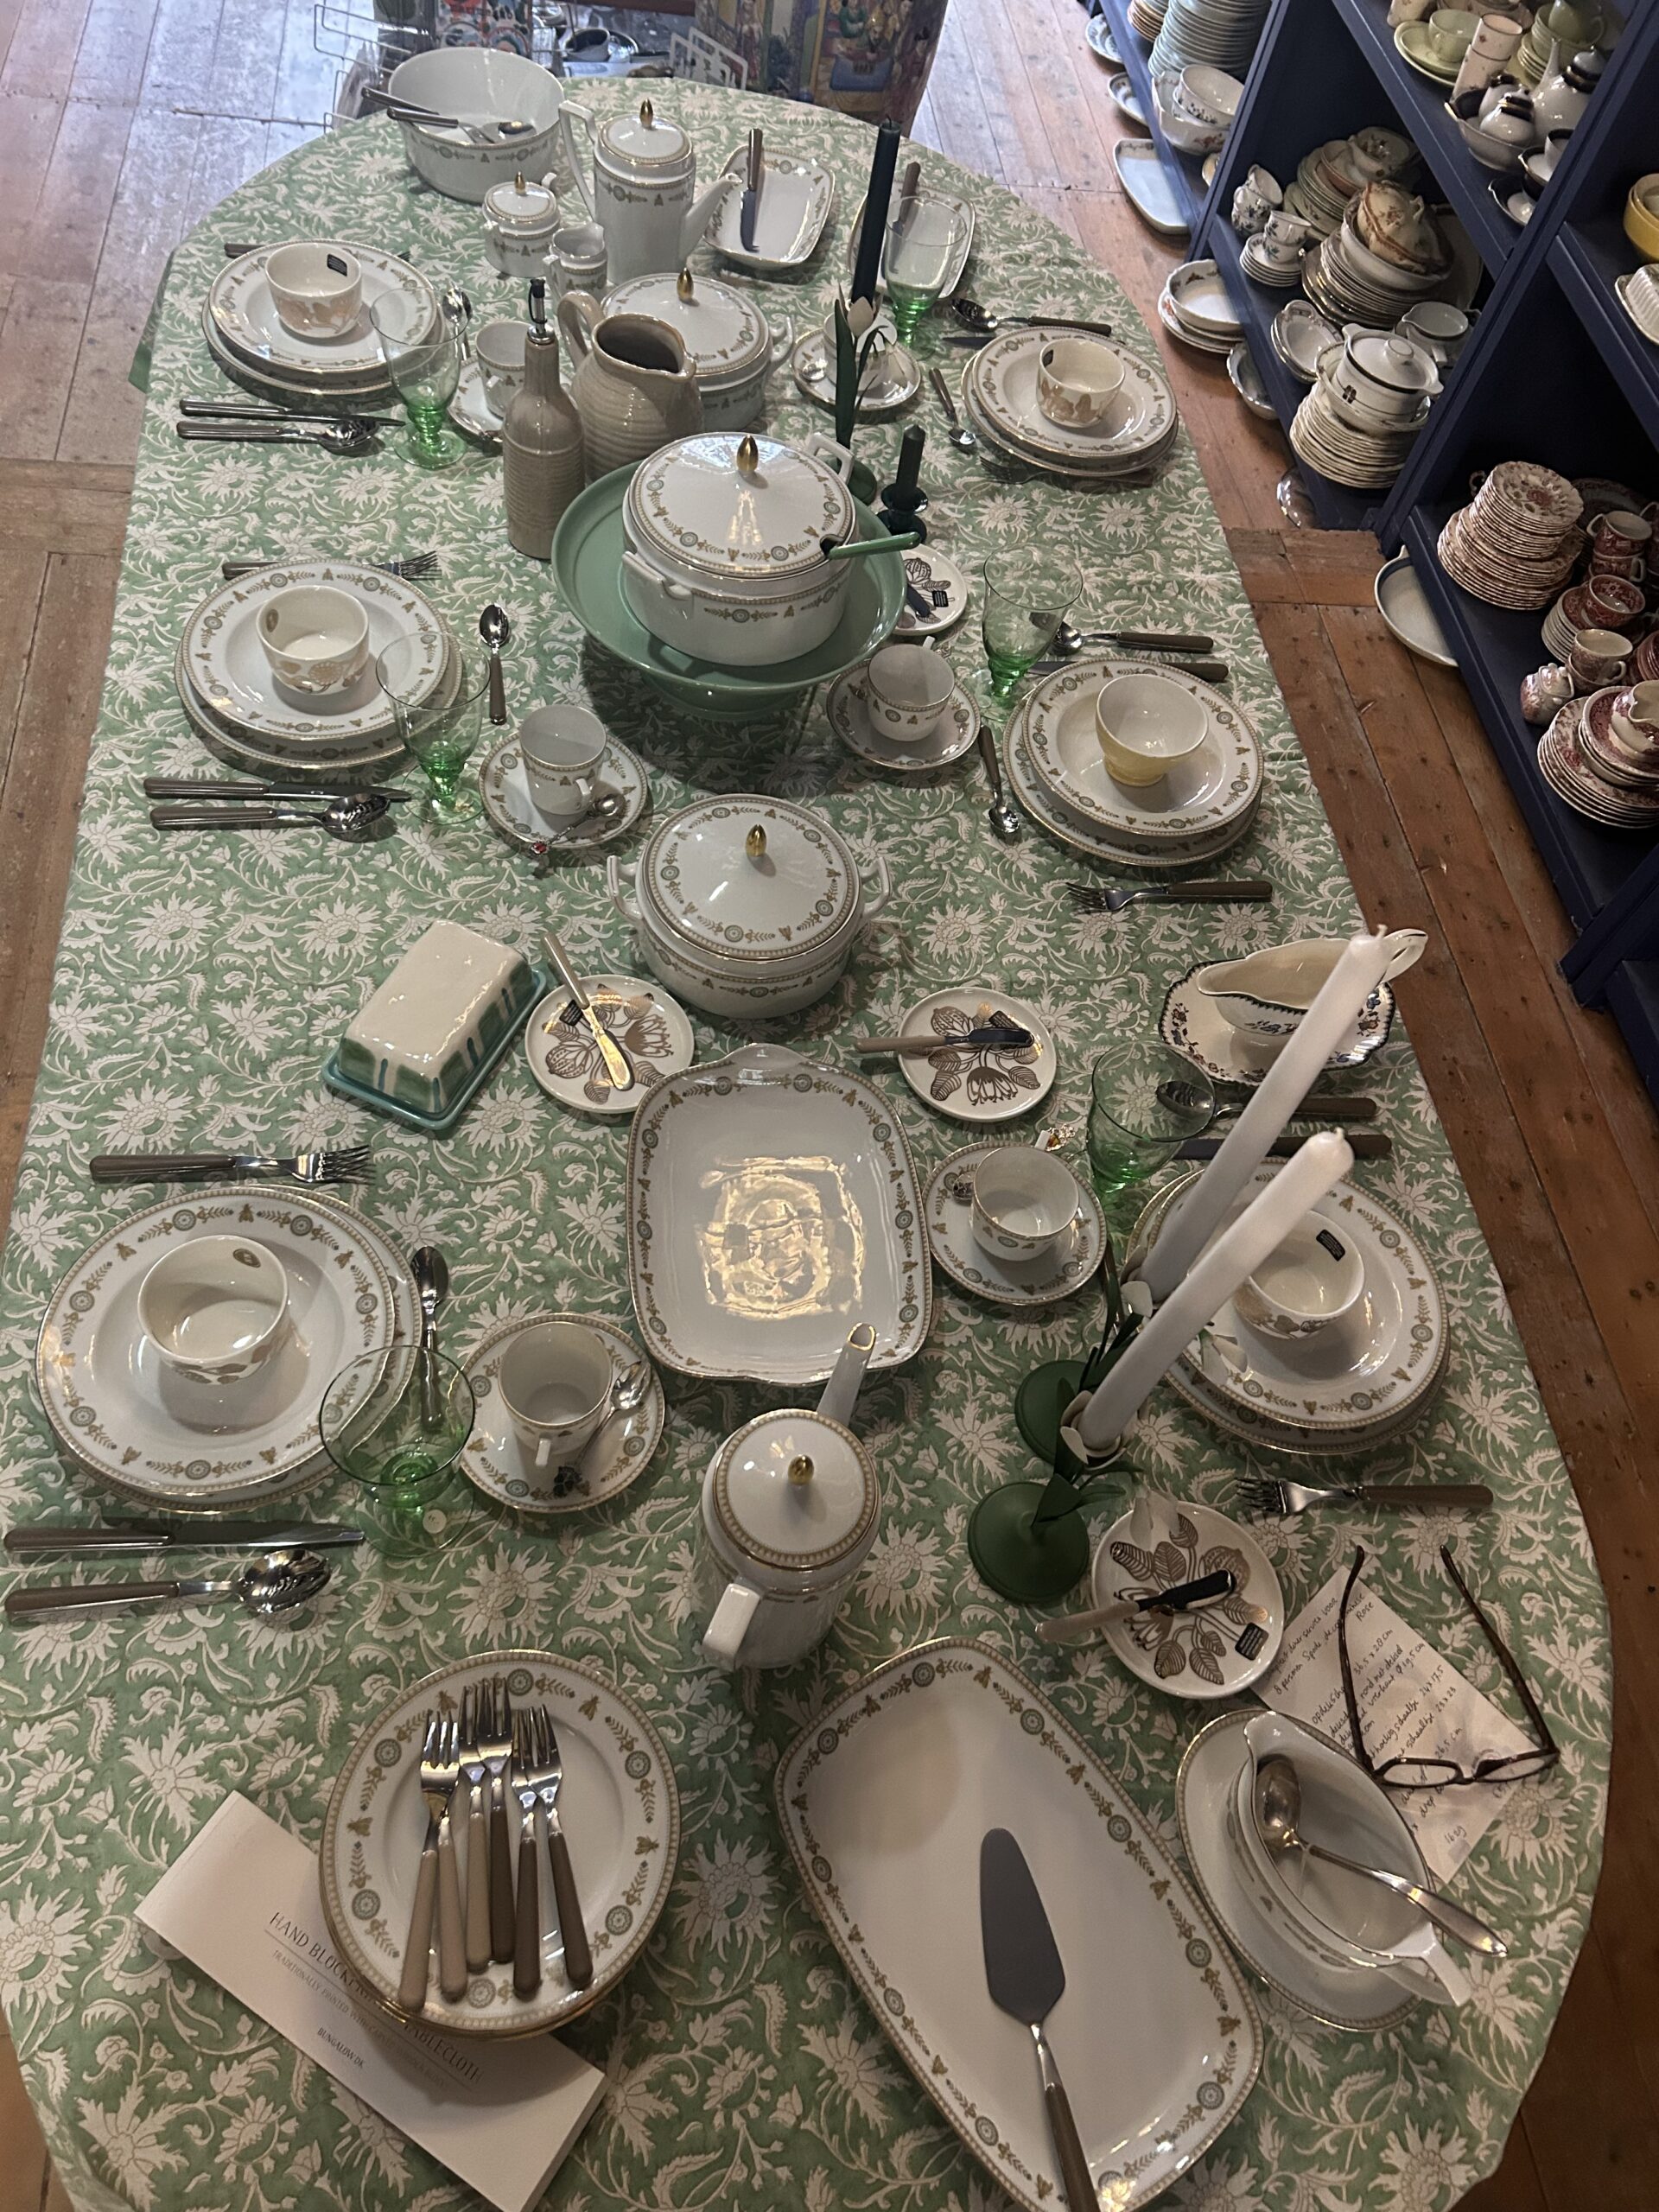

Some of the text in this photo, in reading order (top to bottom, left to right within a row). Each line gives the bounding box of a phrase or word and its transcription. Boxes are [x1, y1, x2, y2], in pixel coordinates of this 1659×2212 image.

[1356, 1602, 1374, 1622] Rose
[1274, 1685, 1282, 1694] 8
[1360, 1677, 1374, 1699] rond
[1374, 1668, 1384, 1682] met
[268, 1910, 312, 1949] HAND
[270, 1949, 321, 1992] TRADITIONALLY
